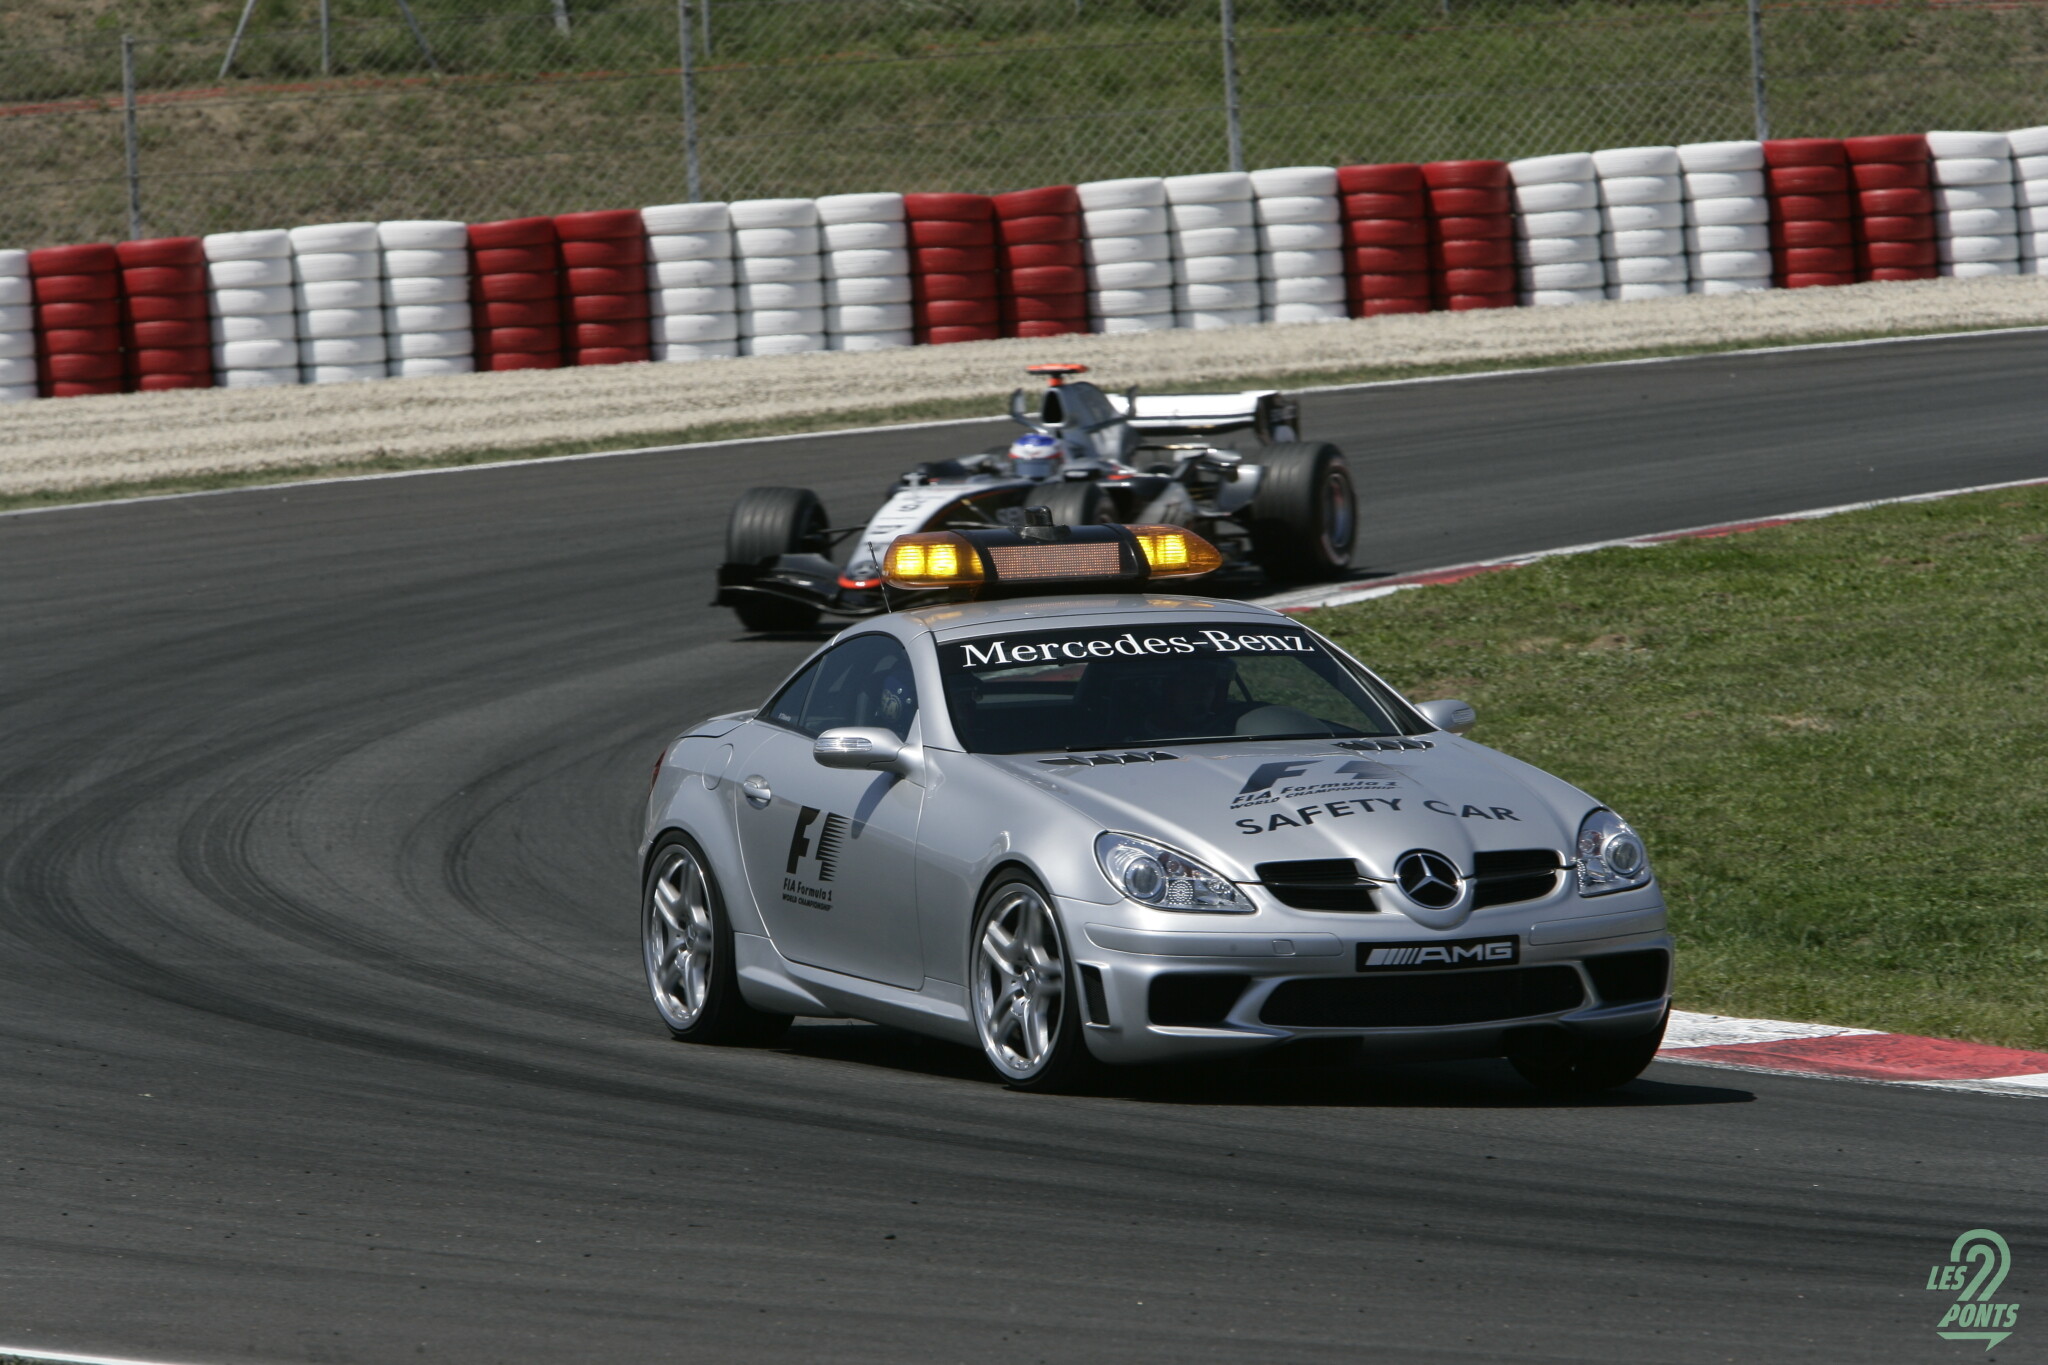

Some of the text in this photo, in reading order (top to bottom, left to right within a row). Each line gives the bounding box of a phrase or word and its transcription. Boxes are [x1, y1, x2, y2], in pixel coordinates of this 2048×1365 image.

[960, 629, 1315, 668] Mercedes-Benz
[1229, 786, 1400, 810] WORLD CHAMPIONSHIP
[1232, 780, 1399, 805] FIA Formula 1
[1235, 797, 1521, 835] SAFETY CAR
[786, 805, 852, 881] F1
[782, 893, 798, 904] WORLD
[783, 877, 833, 902] FIA Formula 1
[1415, 941, 1513, 965] AMG
